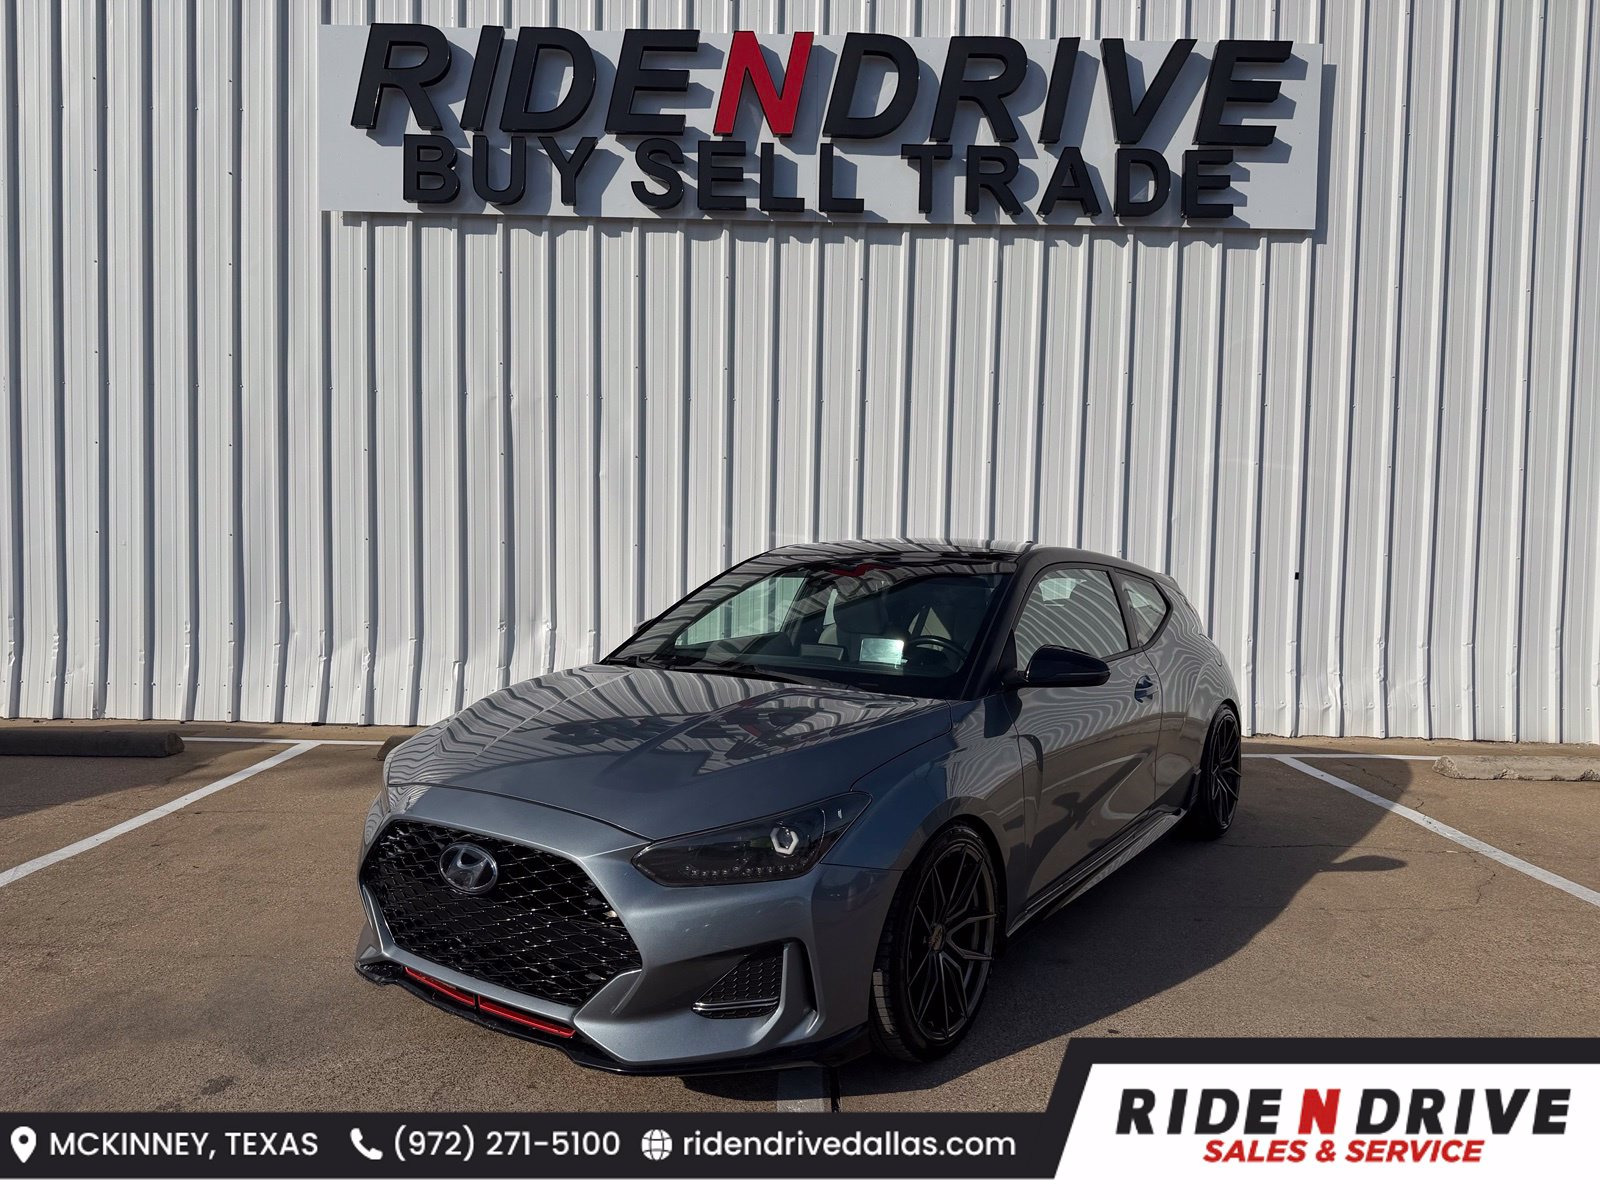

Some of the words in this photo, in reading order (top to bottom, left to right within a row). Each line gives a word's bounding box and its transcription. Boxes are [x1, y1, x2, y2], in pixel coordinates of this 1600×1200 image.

[403, 134, 598, 206] BUY
[631, 138, 864, 213] SELL
[901, 144, 1234, 219] TRADE
